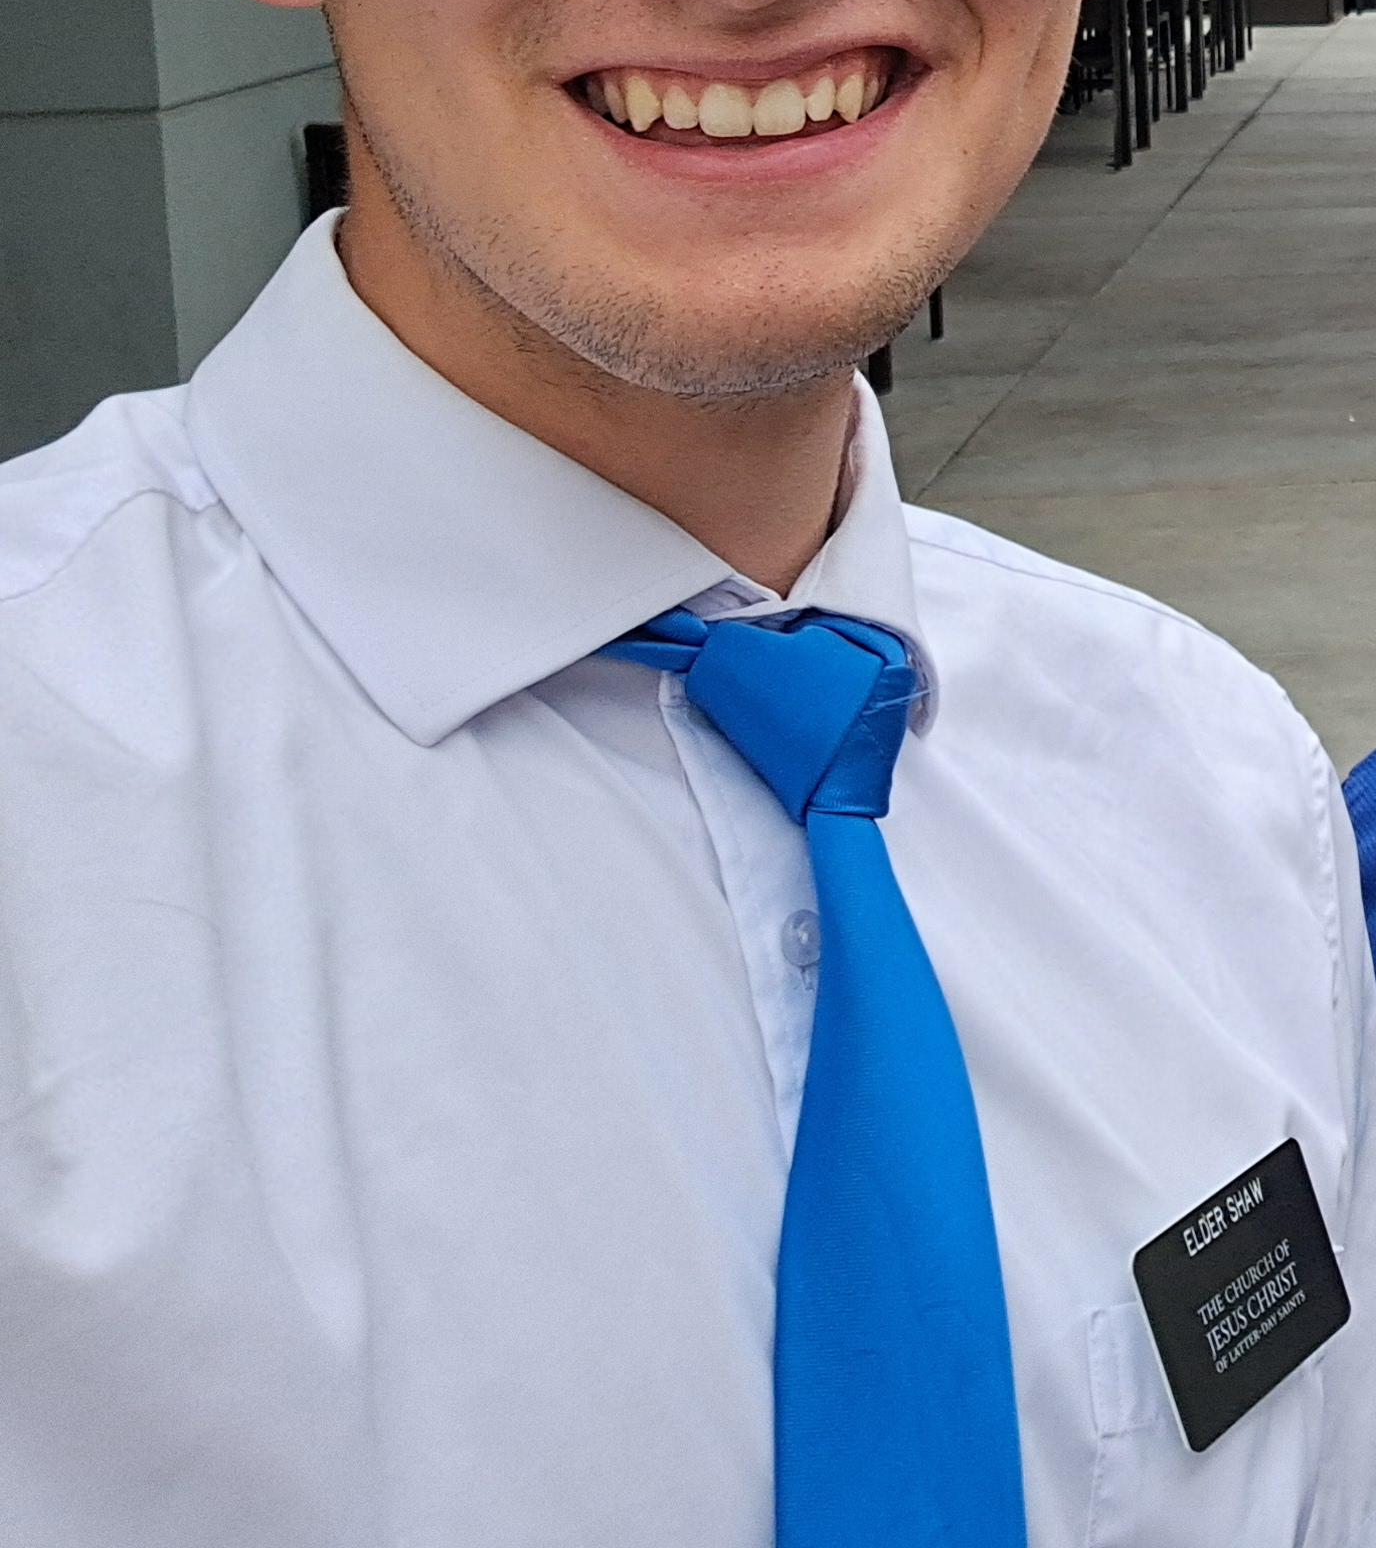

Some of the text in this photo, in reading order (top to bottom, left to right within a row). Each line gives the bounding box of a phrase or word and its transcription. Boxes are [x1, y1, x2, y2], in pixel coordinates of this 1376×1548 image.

[1183, 1176, 1264, 1257] ELDER SHAW
[1197, 1238, 1290, 1326] THE CHURCH OF
[1205, 1261, 1298, 1361] JESUS CHRIST
[1215, 1289, 1306, 1373] OF LATTER-DAY SAINTS
